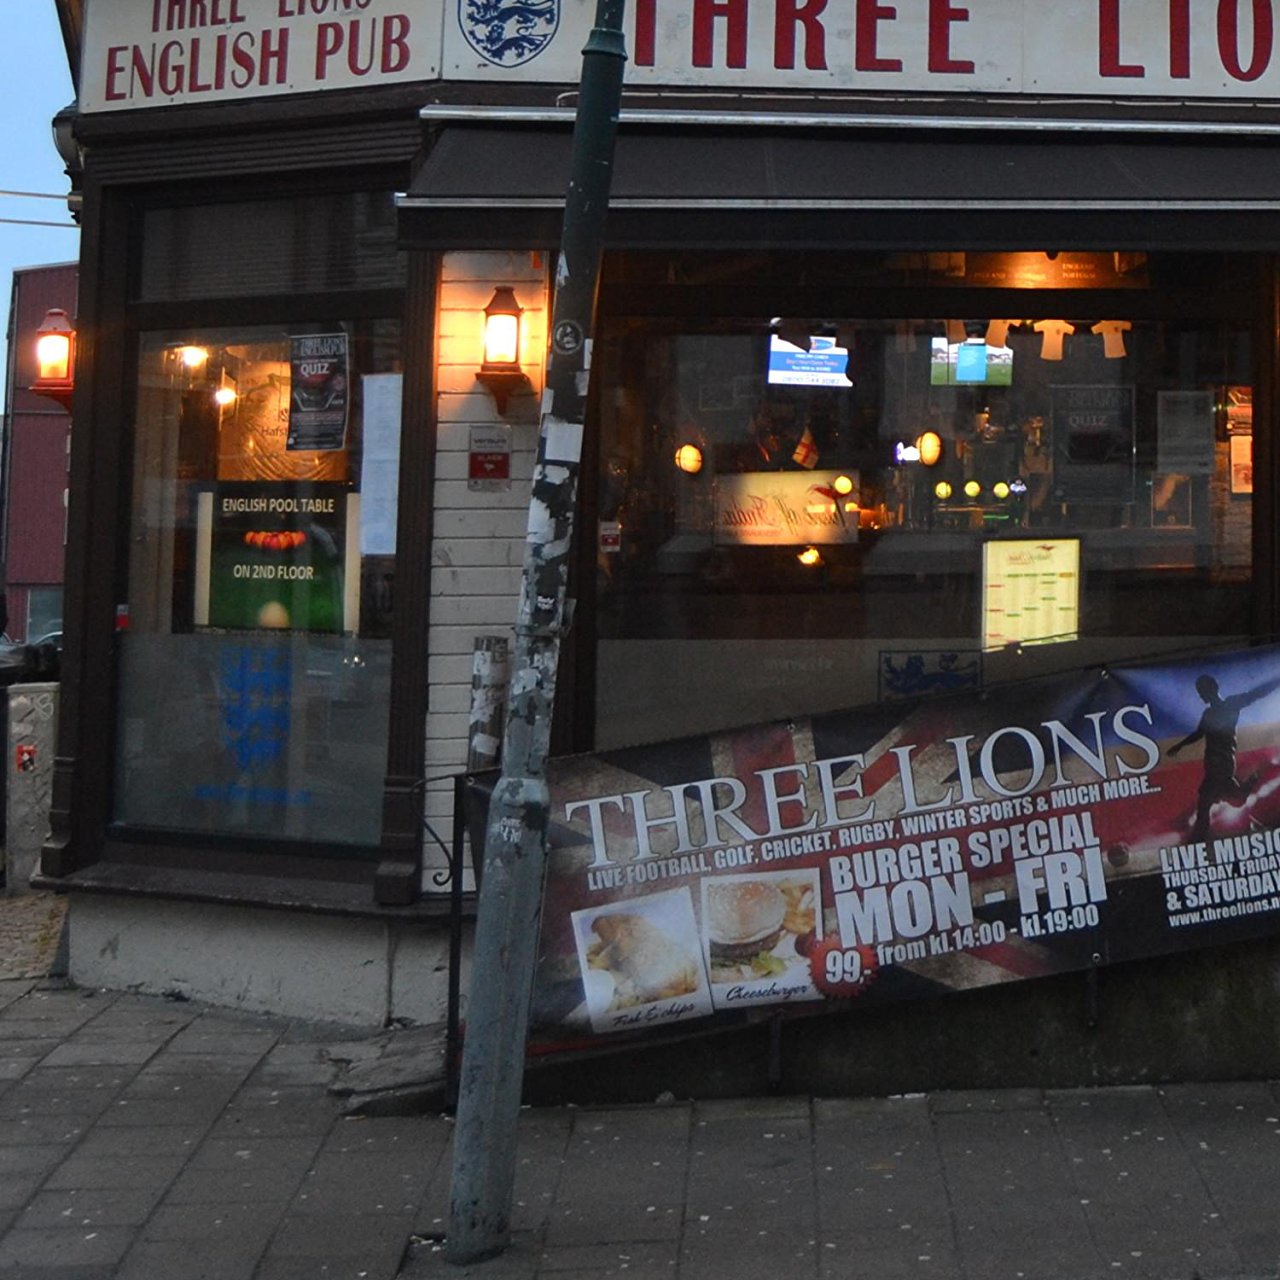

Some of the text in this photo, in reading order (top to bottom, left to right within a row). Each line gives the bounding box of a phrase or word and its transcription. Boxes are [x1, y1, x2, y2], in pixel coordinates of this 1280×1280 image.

[105, 13, 411, 101] ENGLISH PUB
[301, 363, 330, 378] QUIZ
[222, 498, 334, 512] ENGLISH POOL TABLE
[233, 564, 314, 579] ON 2ND FLOOR
[564, 704, 1160, 869] THREE LIONS
[587, 869, 624, 891] LIVE
[626, 854, 711, 884] FOOTBALL,
[714, 845, 759, 870] GOLF,
[761, 831, 837, 861] CRICKET,
[839, 820, 899, 847] RUGBY,
[901, 810, 966, 835] WINTER
[970, 796, 1033, 823] SPORTS
[1036, 796, 1048, 812] &
[1051, 783, 1101, 809] MUCH
[828, 811, 1100, 892] BURGER SPECIAL
[1160, 842, 1210, 873] LIVE
[1162, 864, 1238, 889] THURSDAY,
[834, 846, 1108, 949] MON - FRI
[1166, 891, 1182, 912] &
[877, 940, 925, 967] from
[929, 920, 1006, 954] kl.14:00
[1020, 904, 1100, 938] kl.19:00
[825, 950, 872, 985] 99,-
[726, 981, 809, 1002] Cheeseburger
